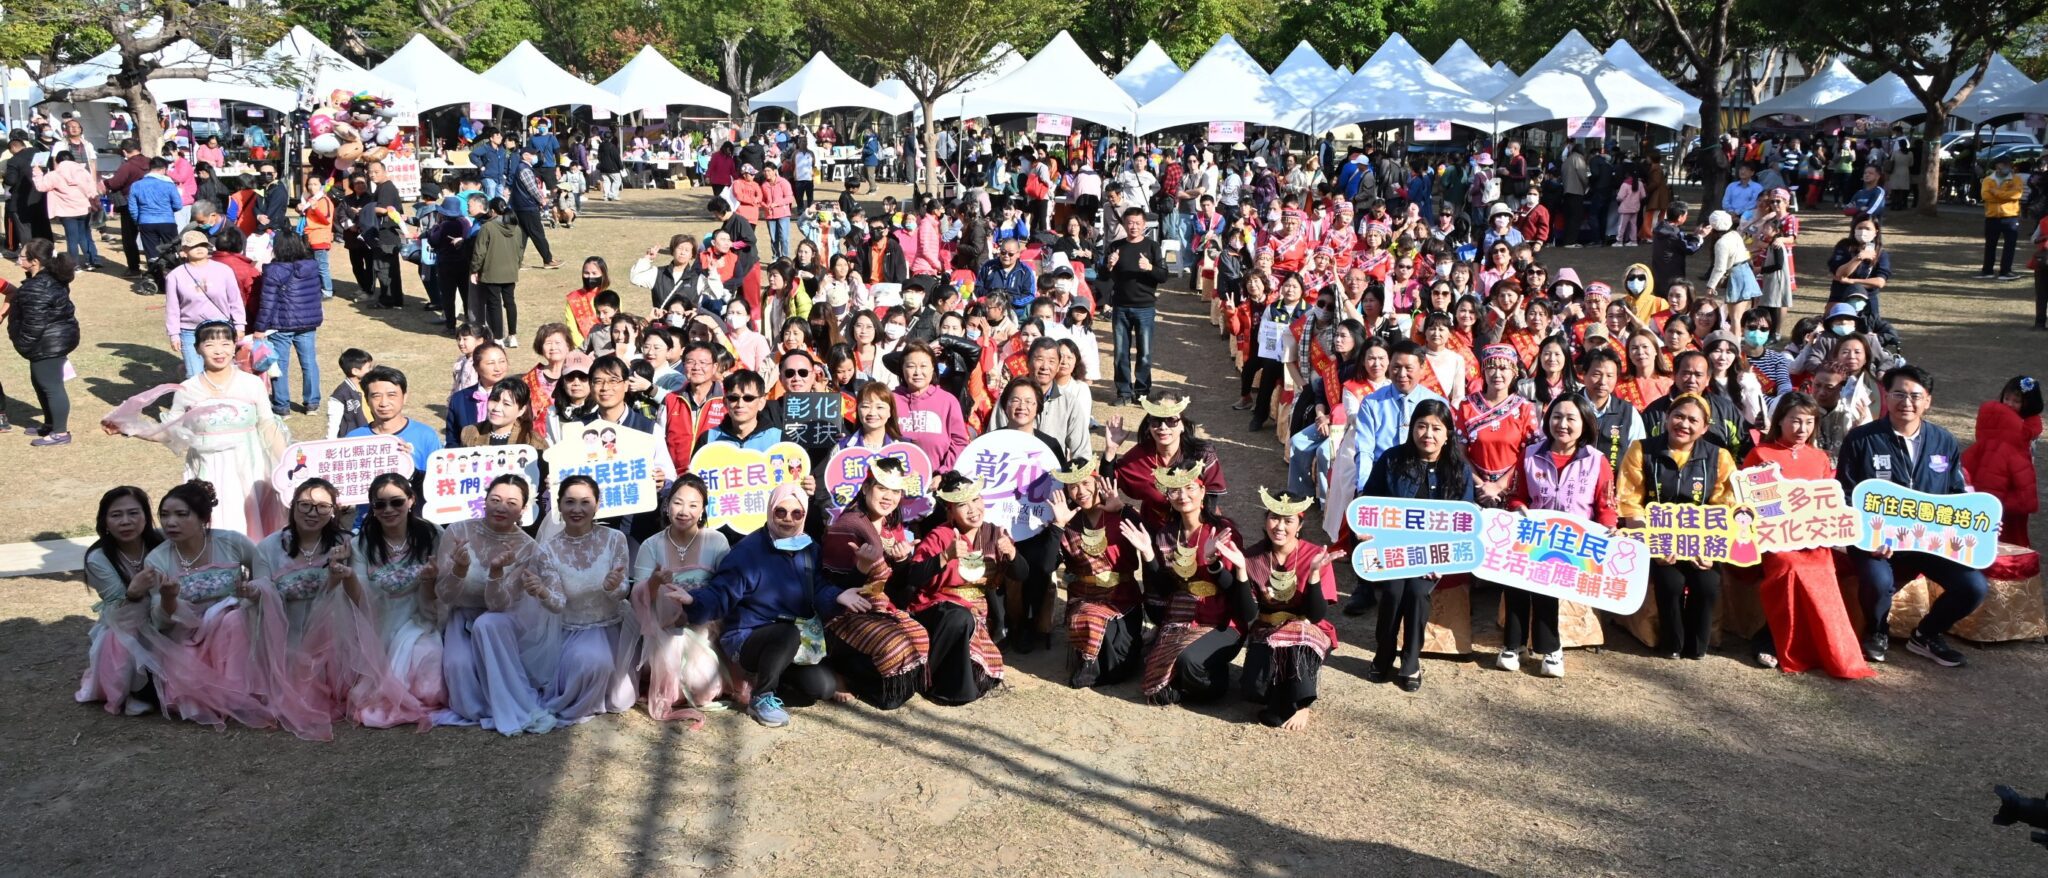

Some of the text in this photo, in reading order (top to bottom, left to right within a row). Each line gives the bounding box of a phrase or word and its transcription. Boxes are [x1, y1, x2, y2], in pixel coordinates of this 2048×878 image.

[787, 397, 838, 418] 彰化
[785, 422, 838, 444] 家扶
[902, 424, 926, 433] FACE
[318, 455, 399, 473] 設籍前新住民
[325, 443, 392, 460] 彰化縣政府
[698, 464, 768, 490] 新住民
[974, 449, 1049, 503] 彰化
[1788, 486, 1837, 512] 多元
[1863, 492, 1991, 532] 新住民團體培力
[1358, 506, 1473, 532] 新住民法律
[1649, 505, 1728, 531] 新住民
[1756, 513, 1856, 545] 文化交流
[1517, 518, 1609, 564] 新住民
[1384, 542, 1473, 569] 諮詢服務
[1482, 547, 1629, 601] 生活適應輔導
